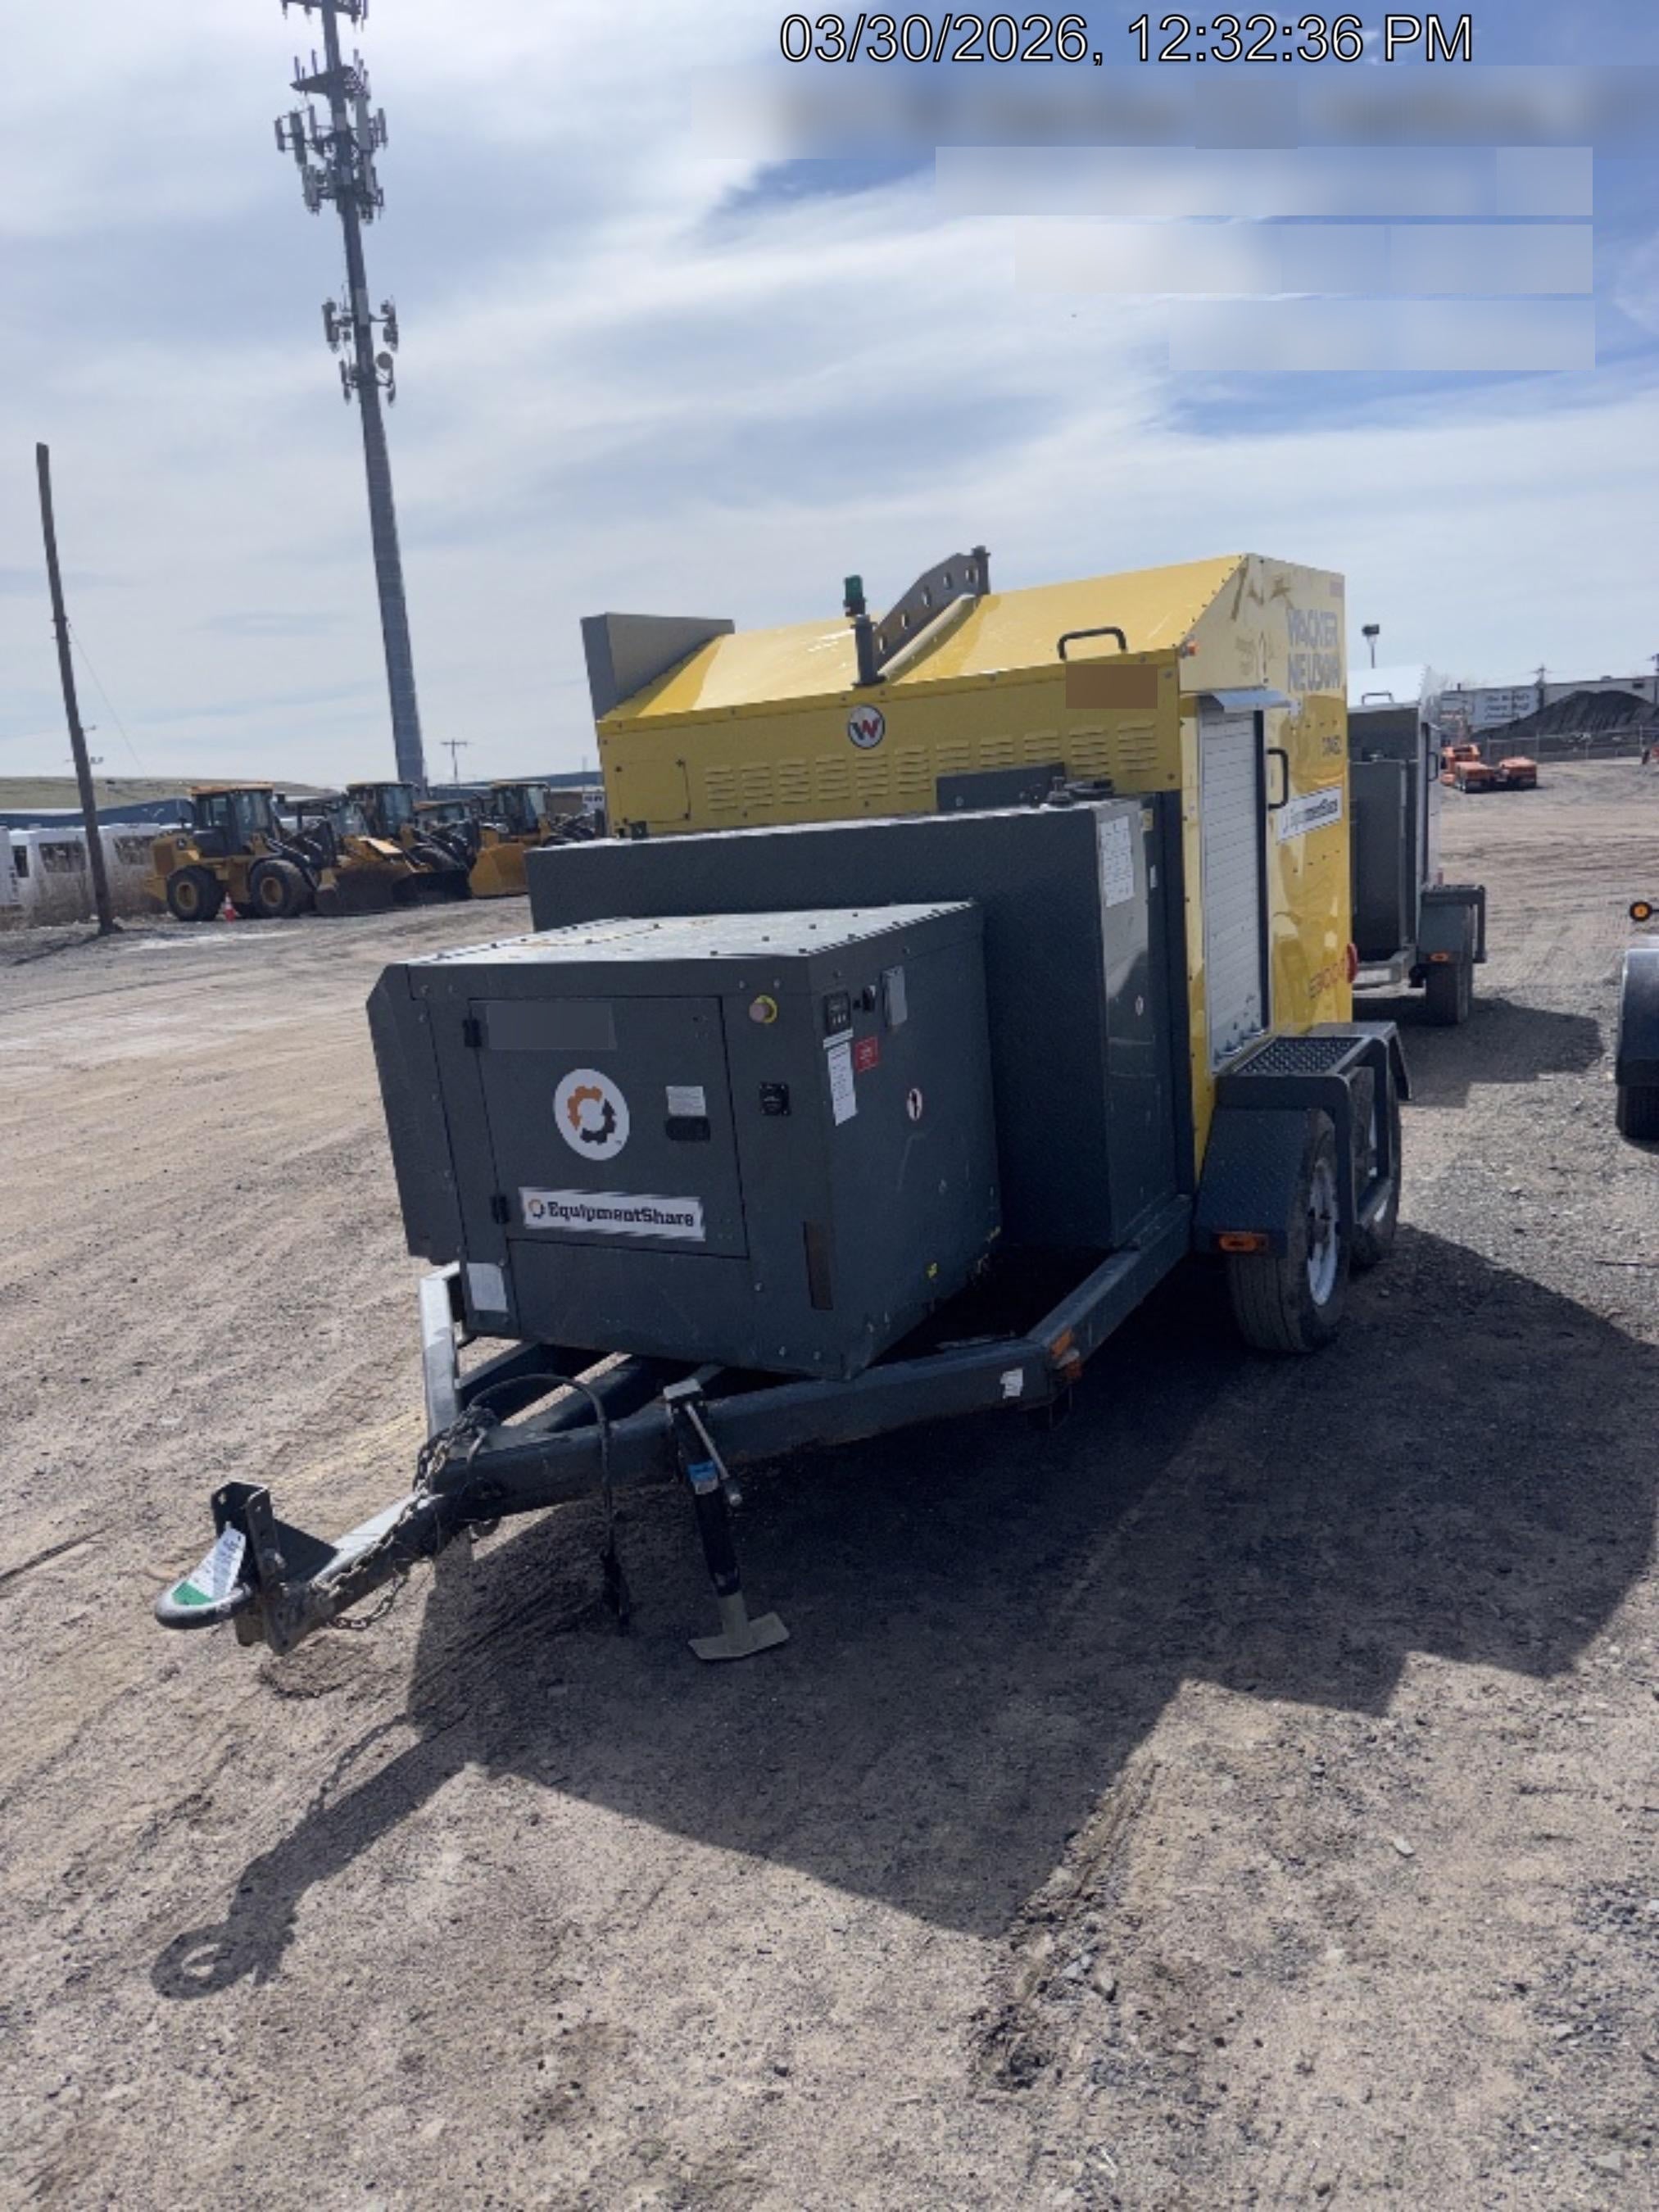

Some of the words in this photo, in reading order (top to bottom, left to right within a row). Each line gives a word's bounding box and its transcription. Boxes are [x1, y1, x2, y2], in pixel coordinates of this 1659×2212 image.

[1286, 609, 1338, 648] WACKER
[1287, 653, 1341, 693] NEUSON
[547, 1200, 695, 1228] EquipmentShare
